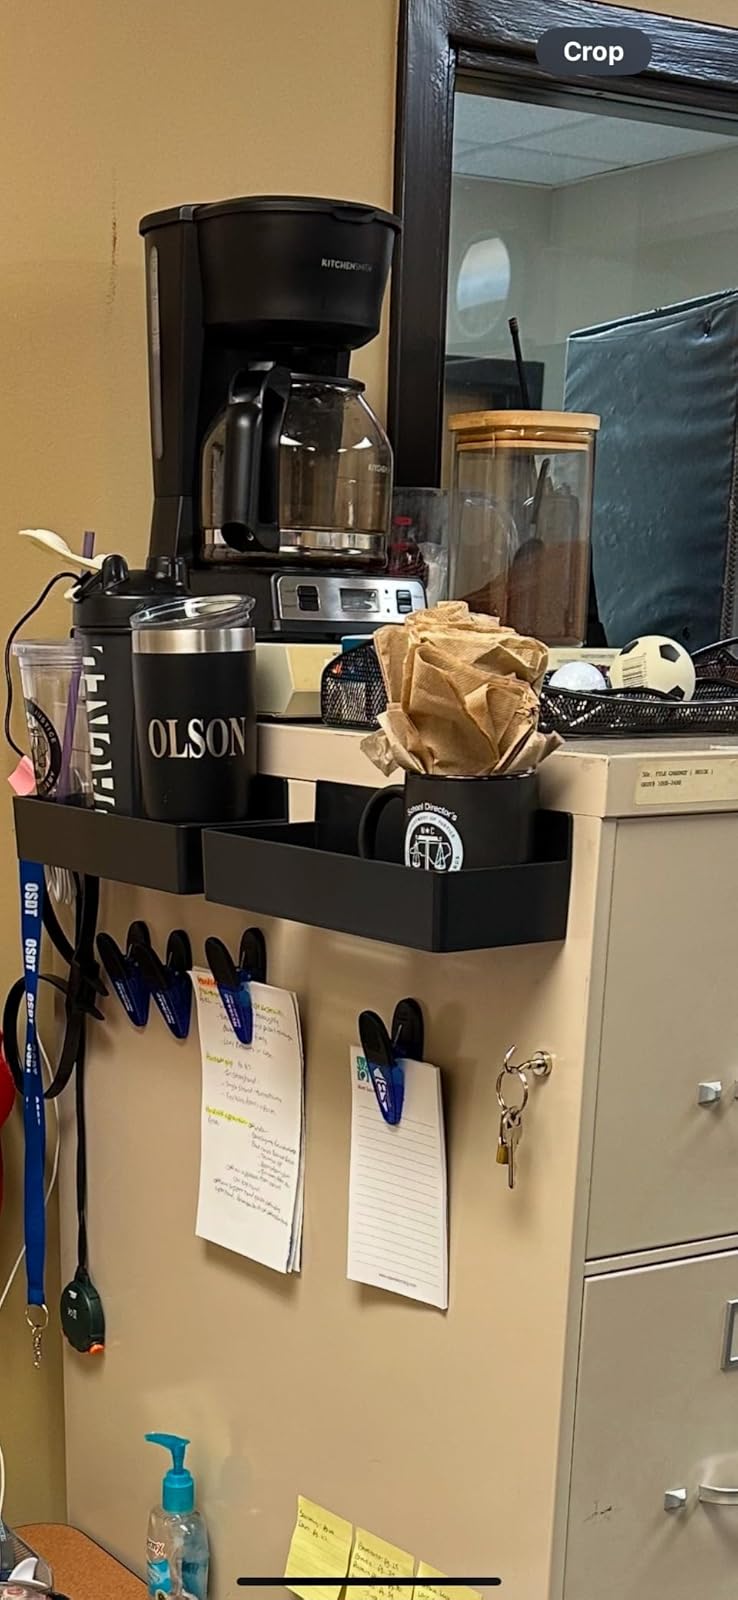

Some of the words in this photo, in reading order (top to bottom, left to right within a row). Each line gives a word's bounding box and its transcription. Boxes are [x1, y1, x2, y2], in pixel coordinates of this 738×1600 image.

[34, 708, 57, 744] JUSTICE
[148, 717, 246, 759] OLSON
[424, 802, 458, 821] Director's
[24, 882, 39, 918] OSDT
[24, 937, 38, 973] OSDT
[26, 992, 35, 1025] OSDT
